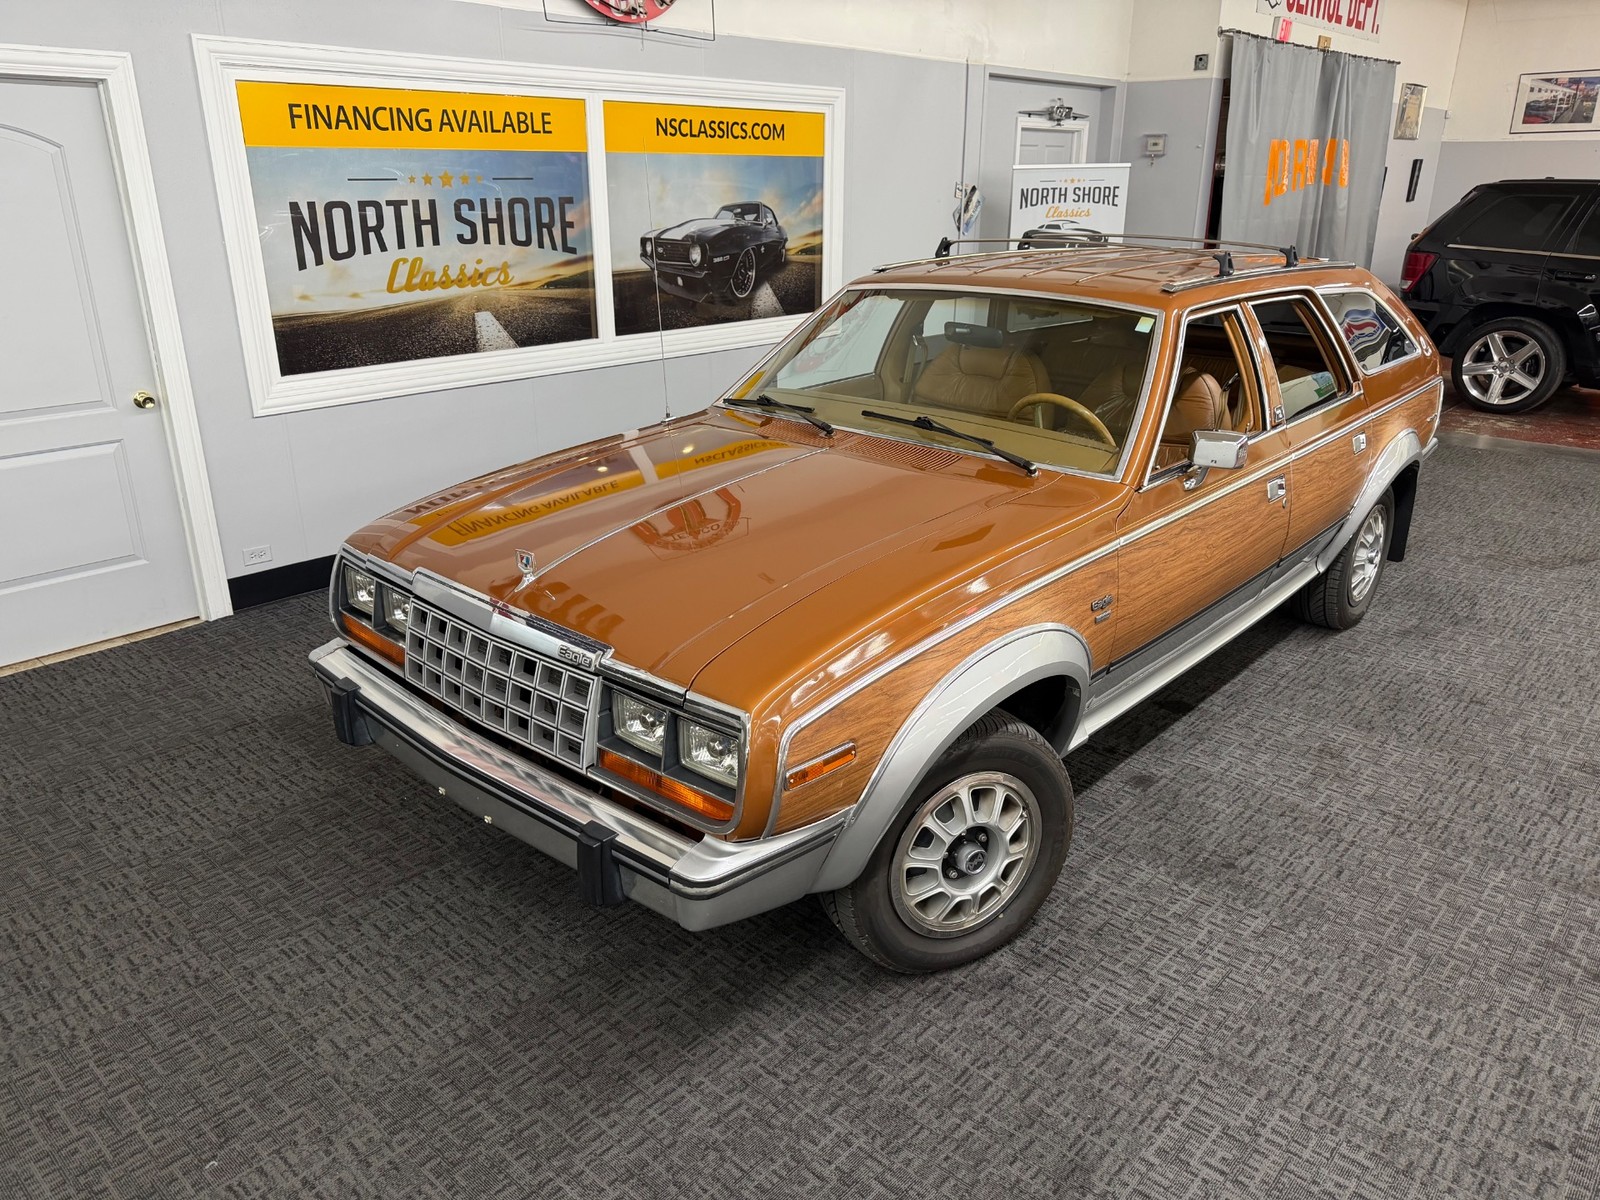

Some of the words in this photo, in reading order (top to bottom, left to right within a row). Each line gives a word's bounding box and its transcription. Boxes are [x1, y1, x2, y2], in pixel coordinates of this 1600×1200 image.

[288, 103, 433, 131] FINANCING
[438, 108, 553, 134] AVAILABLE
[655, 118, 785, 140] NSCLASSICS.COM
[1019, 187, 1068, 210] NORTH
[1072, 186, 1120, 207] SHORE
[1045, 206, 1092, 219] Classics
[289, 198, 441, 271] NORTH
[453, 195, 578, 255] SHORE
[386, 256, 514, 294] Classics
[558, 645, 592, 667] Eagle
